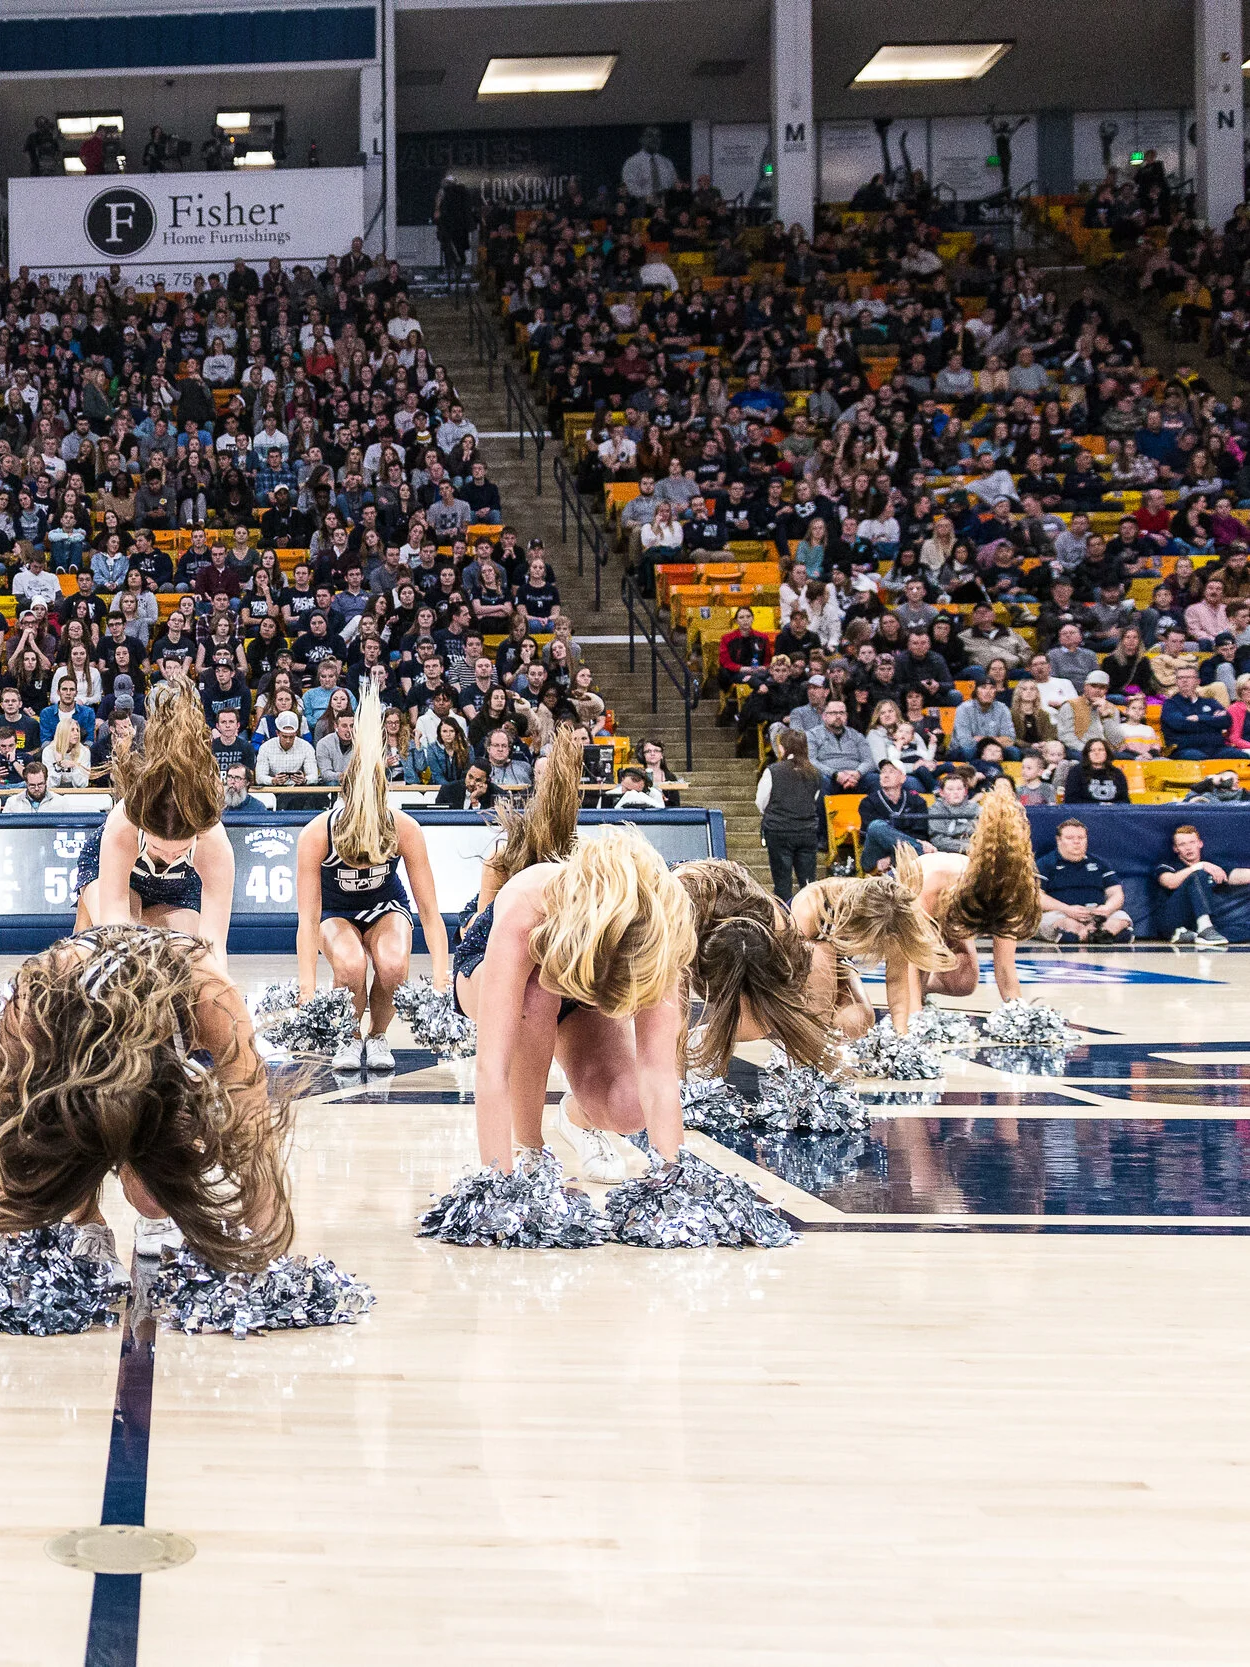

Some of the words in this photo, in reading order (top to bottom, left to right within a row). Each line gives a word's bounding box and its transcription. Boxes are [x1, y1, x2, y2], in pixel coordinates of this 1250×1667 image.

[1218, 109, 1235, 130] N
[785, 123, 806, 142] M
[168, 191, 285, 230] Fisher
[104, 202, 136, 243] F
[162, 231, 206, 246] Home
[209, 229, 291, 246] Furnishings
[244, 828, 295, 844] NEVADA
[245, 865, 293, 904] 46
